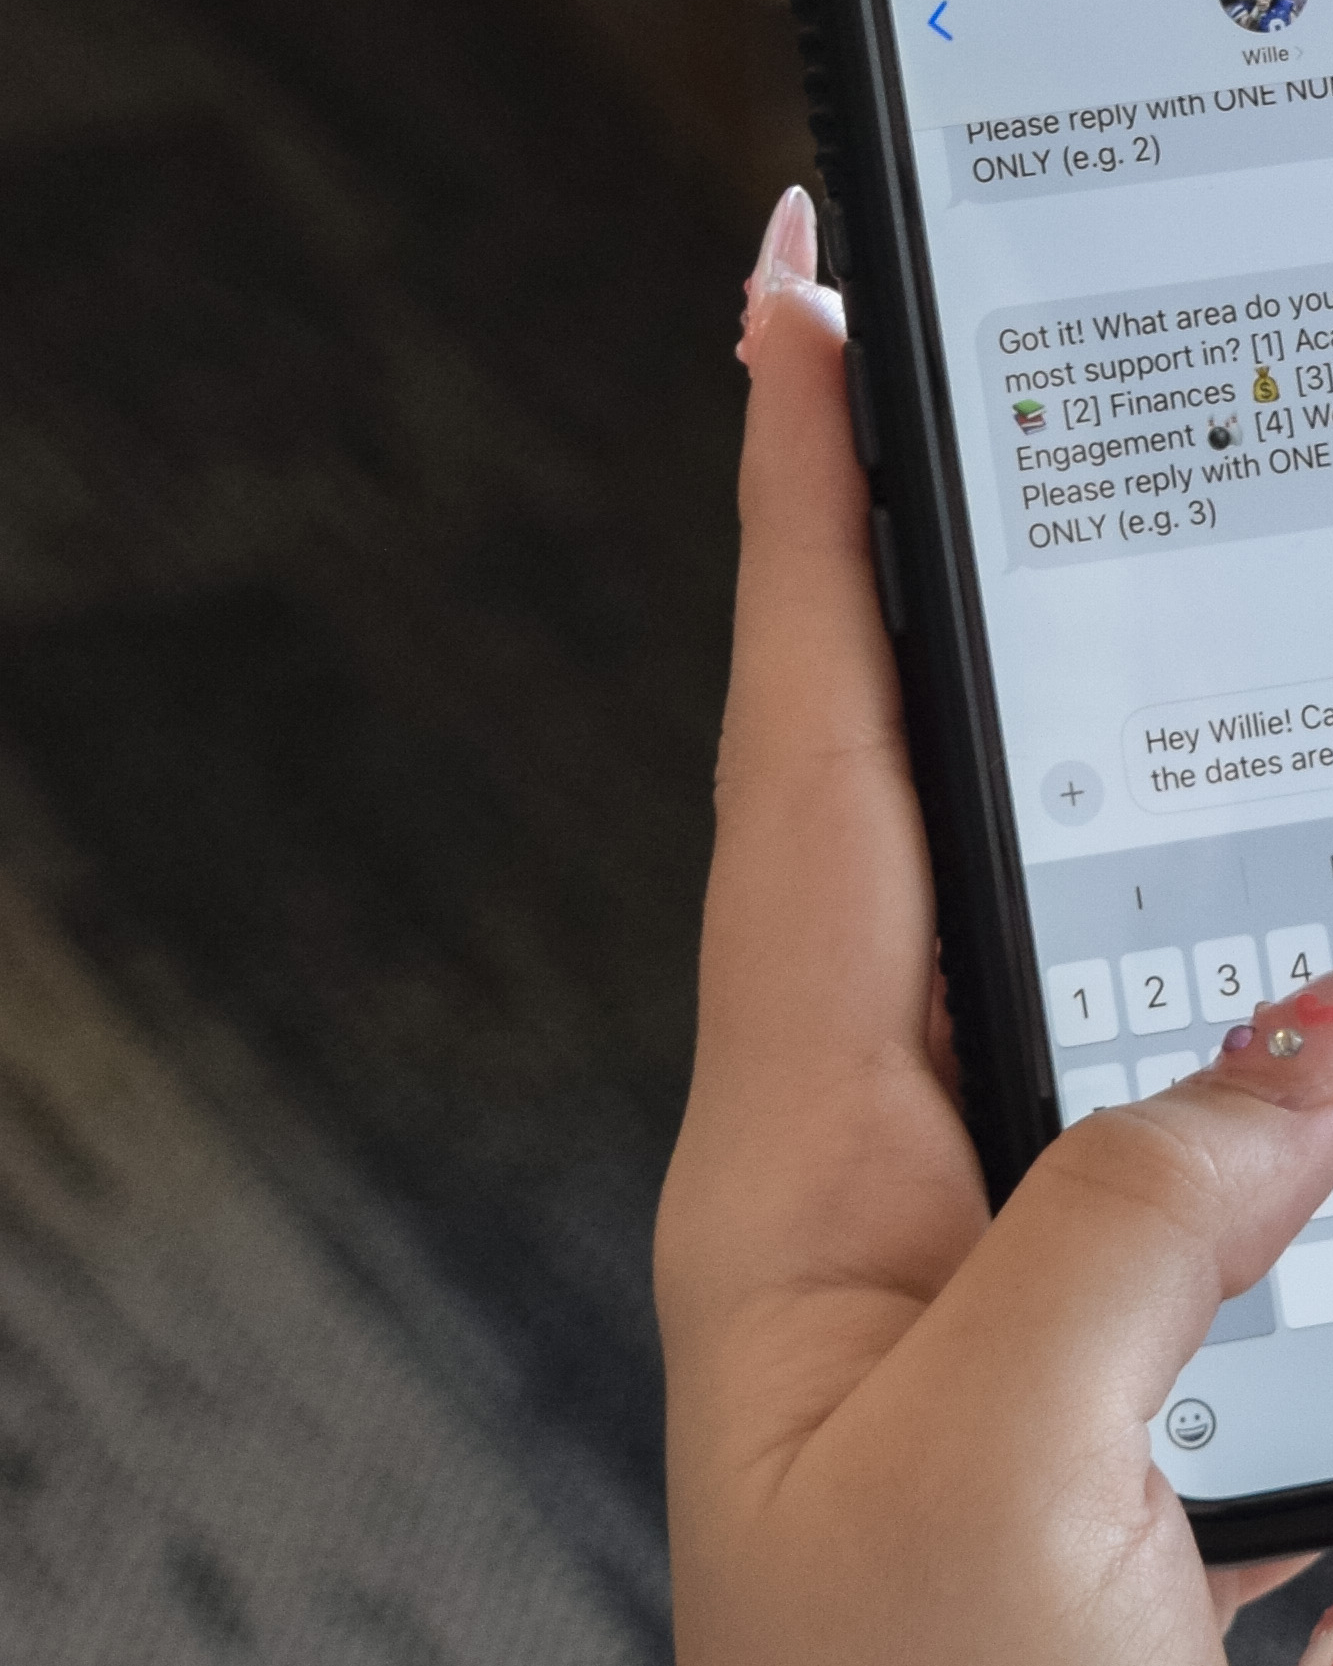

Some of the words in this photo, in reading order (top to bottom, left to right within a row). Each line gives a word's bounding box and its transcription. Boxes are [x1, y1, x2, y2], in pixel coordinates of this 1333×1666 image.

[1242, 46, 1289, 66] Wille
[966, 115, 1060, 144] Please
[1069, 104, 1137, 133] reply
[1146, 94, 1205, 120] with
[1214, 85, 1277, 111] ONE
[973, 149, 1050, 183] ONLY
[1064, 146, 1124, 176] (e.g.
[1133, 135, 1160, 165] 2)
[999, 326, 1051, 354] Got
[1057, 320, 1084, 346] it!
[1092, 310, 1168, 340] What
[1176, 305, 1237, 330] area
[1245, 294, 1280, 320] do
[1005, 363, 1076, 393] most
[1084, 346, 1194, 383] support
[1201, 338, 1240, 365] in?
[1251, 330, 1284, 364] [1]
[1063, 395, 1101, 430] [2]
[1110, 383, 1237, 423] Finances
[1016, 425, 1196, 471] Engagement
[1255, 408, 1294, 442] [4]
[1022, 480, 1115, 510] Please
[1125, 464, 1192, 497] reply
[1201, 453, 1261, 483] with
[1269, 442, 1332, 474] ONE
[1029, 514, 1106, 548] ONLY
[1119, 510, 1179, 541] (e.g.
[1188, 498, 1216, 528] 3)
[1146, 728, 1199, 754] Hey
[1208, 709, 1292, 743] Willie!
[1151, 766, 1196, 792] the
[1205, 755, 1283, 784] dates
[1292, 747, 1333, 771] are
[1073, 988, 1089, 1019] 1
[1145, 976, 1167, 1009] 2
[1217, 964, 1240, 996] 3
[1290, 952, 1312, 981] 4
